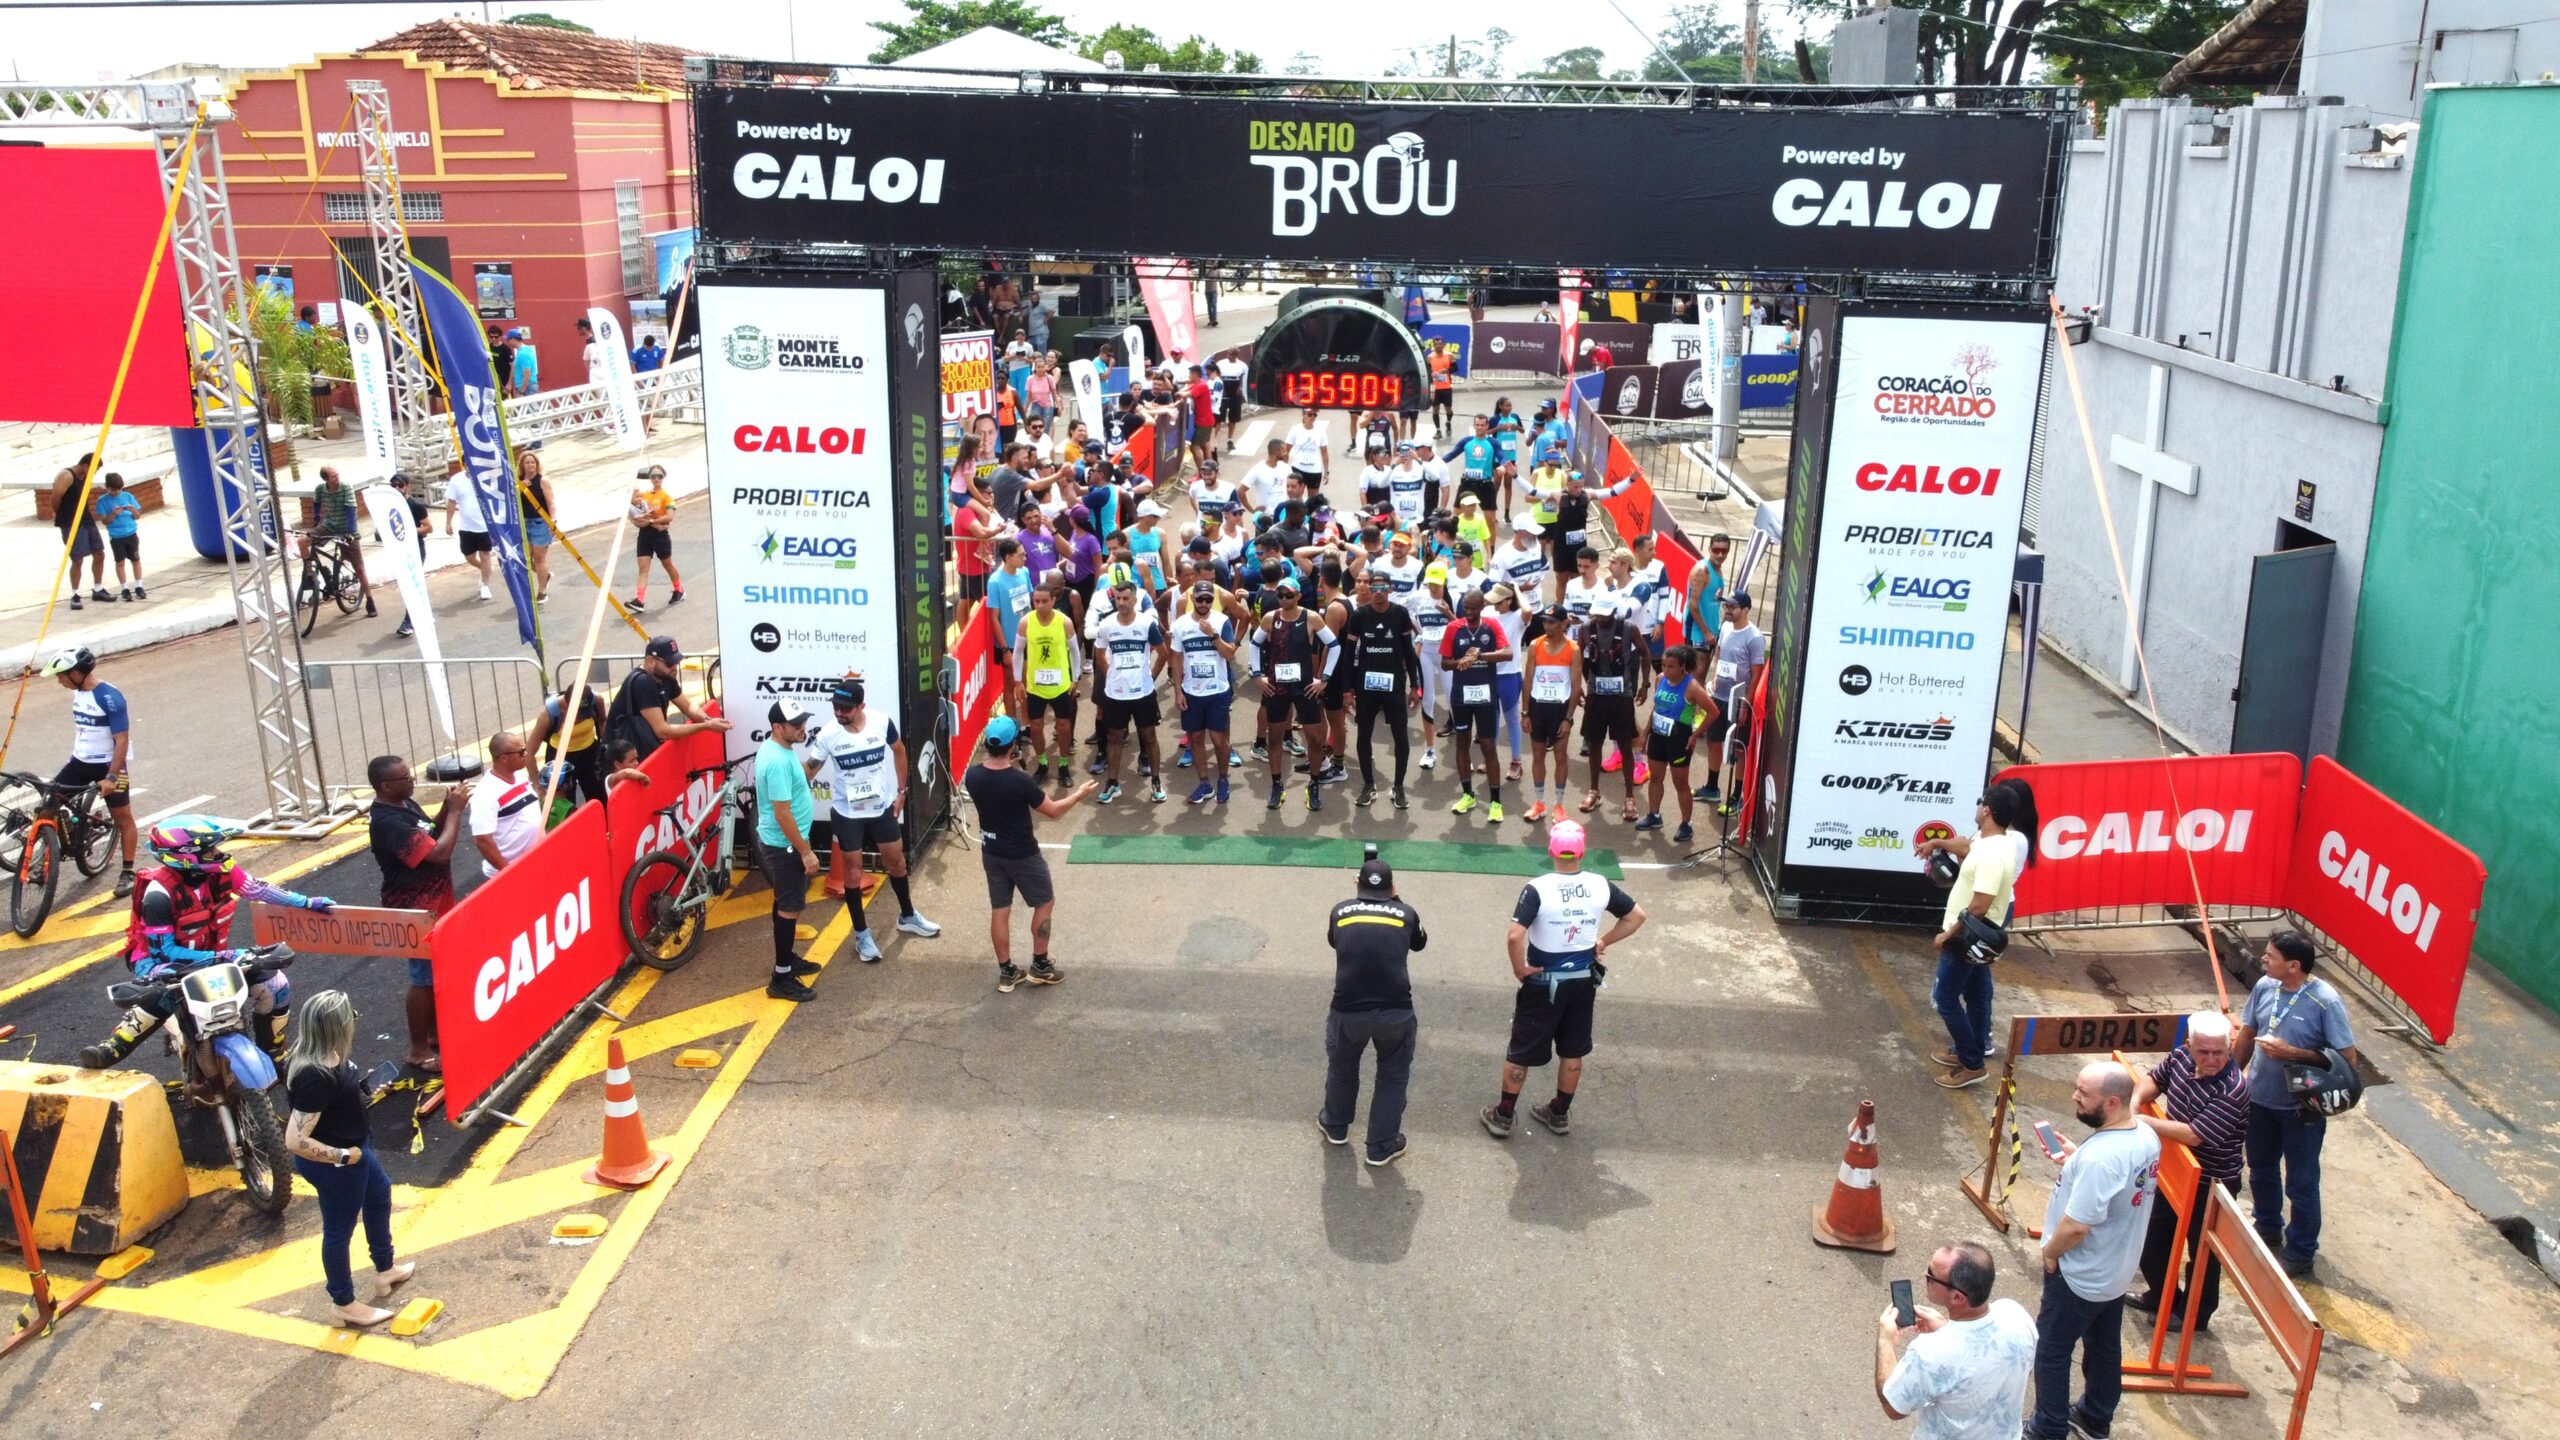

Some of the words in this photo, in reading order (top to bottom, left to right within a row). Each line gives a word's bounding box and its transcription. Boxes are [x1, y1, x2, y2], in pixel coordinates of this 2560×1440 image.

[736, 119, 823, 141] Powered
[826, 122, 851, 146] by
[1249, 120, 1355, 152] DESAFIO
[1782, 145, 1875, 166] Powered
[1878, 148, 1905, 170] by
[733, 152, 946, 204] CALOI
[1249, 148, 1458, 237] BROU
[1772, 177, 2002, 231] CALOI
[777, 338, 839, 354] MONTE
[941, 341, 989, 363] NOVO
[1519, 340, 1545, 349] Buttered
[778, 353, 864, 369] CARMELO
[941, 360, 990, 379] PRONTO
[1319, 354, 1360, 363] POLAR
[941, 376, 991, 394] SOCORRO
[1877, 375, 1967, 397] CORAÇÃO
[1976, 387, 1991, 396] DO
[941, 390, 992, 420] UFU
[1873, 392, 1996, 418] CERRADO
[1880, 414, 1908, 425] Região
[1910, 416, 1921, 424] de
[1923, 417, 1985, 427] Oportunidades
[733, 424, 866, 455] CALOI
[912, 414, 929, 518] BROU
[1855, 462, 2001, 496] CALOI
[1793, 437, 1812, 555] BROU
[757, 509, 789, 517] MADE
[795, 510, 818, 518] FOR
[825, 510, 848, 518] YOU
[783, 536, 857, 558] EALOG
[1868, 547, 1902, 557] MADE
[1910, 548, 1934, 557] FOR
[1942, 550, 1966, 559] YOU
[743, 585, 869, 606] SHIMANO
[1890, 576, 1971, 600] EALOG
[914, 533, 933, 692] DESAFIO
[787, 629, 810, 642] Hot
[814, 630, 867, 644] Buttered
[1839, 626, 1975, 650] SHIMANO
[1120, 656, 1135, 664] 716
[1774, 560, 1800, 738] DESAFIO
[756, 676, 865, 694] KING
[962, 649, 987, 721] CALOI
[1879, 672, 1904, 685] Hot
[1909, 673, 1965, 689] Buttered
[1834, 718, 1956, 741] KINGS
[839, 756, 865, 767] TRAIL
[1821, 773, 1951, 795] GOODYEAR
[1904, 794, 1933, 803] BICYCLE
[1934, 796, 1954, 804] TIRES
[1865, 827, 1899, 839] clube
[2038, 807, 2253, 861] CALOI
[2317, 830, 2441, 953] CALOI
[1338, 902, 1405, 917] FOTÓGRAFO
[345, 920, 419, 949] IMPEDIDO
[474, 877, 590, 1022] CALOI
[2058, 1017, 2161, 1050] OBRAS
